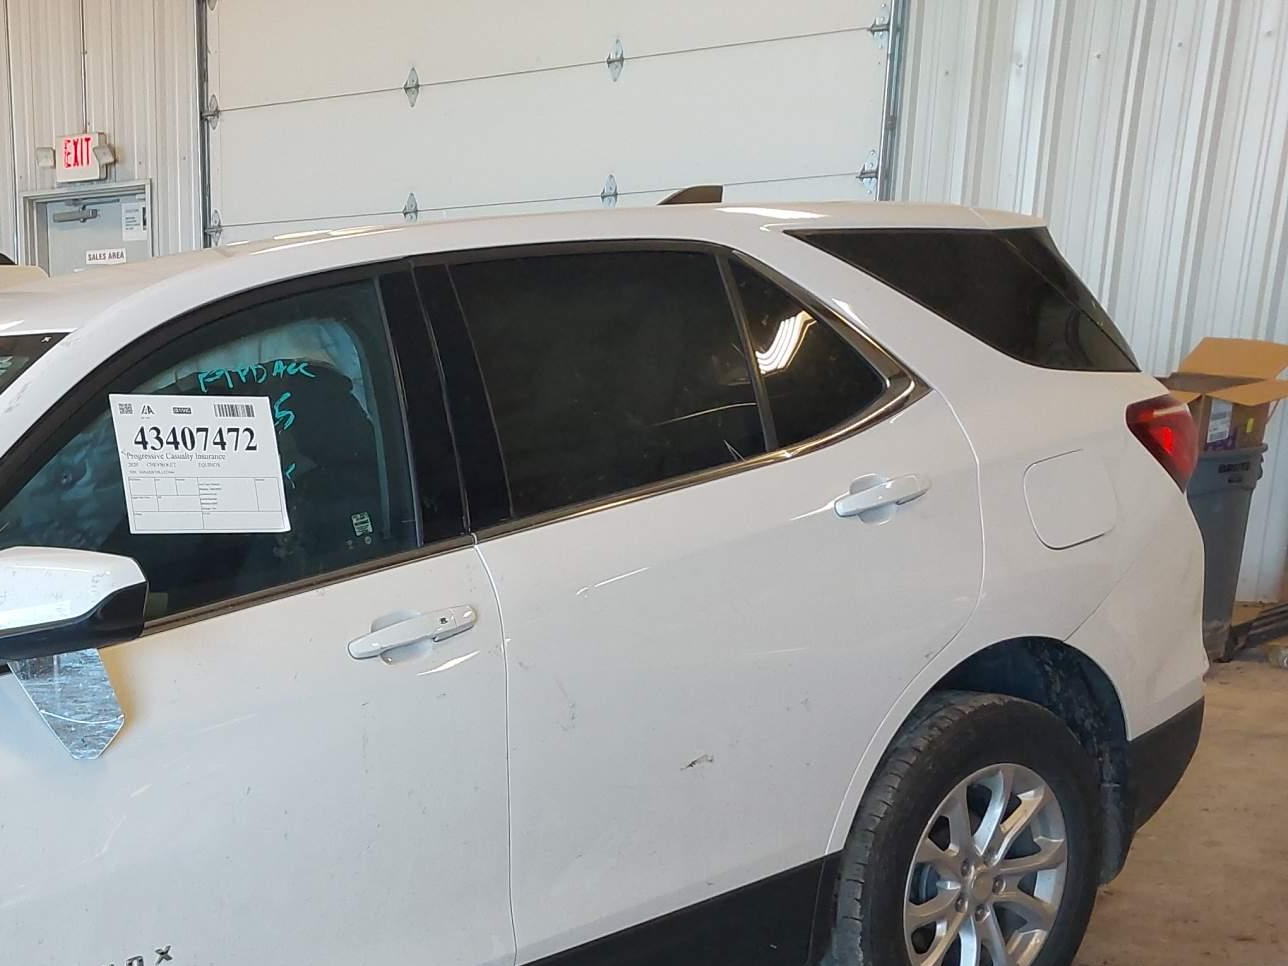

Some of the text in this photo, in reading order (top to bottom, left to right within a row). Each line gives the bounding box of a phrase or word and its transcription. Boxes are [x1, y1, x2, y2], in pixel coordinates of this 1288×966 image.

[64, 137, 91, 168] EXIT
[88, 251, 124, 261] SALES AREA
[134, 426, 257, 451] 43407472
[126, 452, 226, 462] Progressive Casualty Insurance
